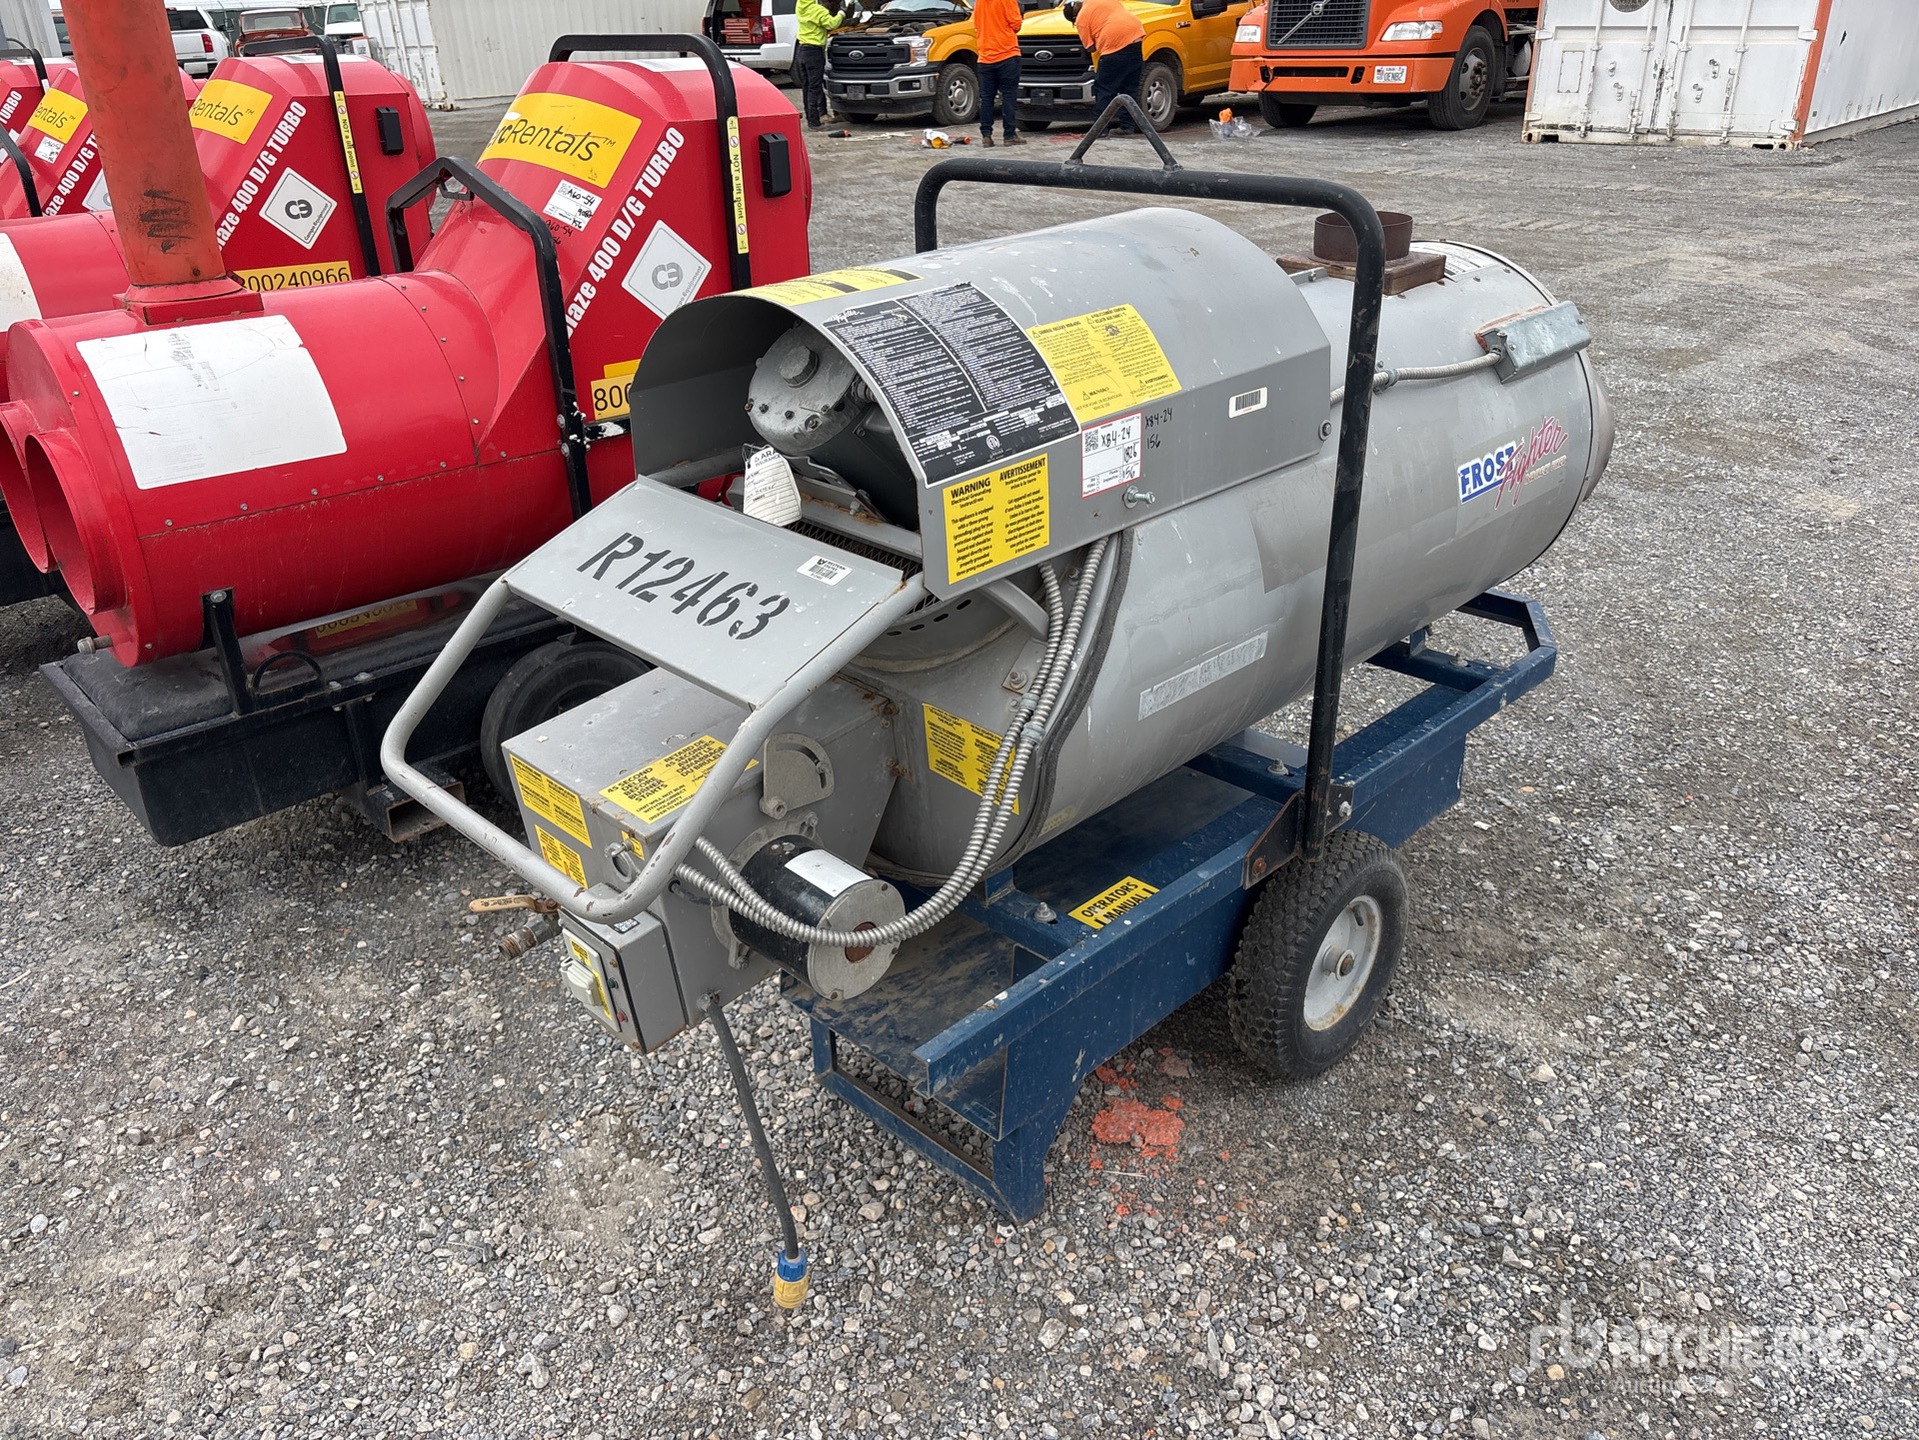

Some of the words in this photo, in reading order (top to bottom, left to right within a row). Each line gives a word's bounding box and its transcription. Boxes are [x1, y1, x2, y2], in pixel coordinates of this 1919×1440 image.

[347, 151, 355, 167] point
[60, 170, 80, 196] 400
[71, 147, 95, 173] D/G
[217, 211, 240, 251] laze
[231, 179, 258, 213] 400
[249, 150, 277, 184] D/G
[266, 101, 307, 158] TURBO
[736, 197, 744, 219] point
[564, 281, 597, 340] laze
[588, 237, 621, 282] 400
[611, 195, 646, 241] D/G
[634, 126, 685, 198] TURBO
[682, 265, 702, 297] Equipment
[1145, 408, 1172, 429] X84-24
[1101, 426, 1131, 448] X84-24
[1147, 433, 1160, 449] 156
[999, 457, 1045, 481] AVERTISSEMENT
[1460, 445, 1515, 496] FROST
[1495, 415, 1568, 510] Fighter
[950, 477, 990, 498] WARNING
[576, 532, 791, 640] R12463
[663, 746, 694, 761] RETARD
[674, 740, 715, 761] SECONDES
[676, 752, 703, 766] AVANT
[617, 767, 653, 786] SECOND
[620, 776, 649, 790] DELAY
[623, 777, 657, 794] BEFORE
[627, 780, 663, 798] BURNER
[634, 783, 668, 801] STARTS
[1103, 893, 1148, 922] MANUAL
